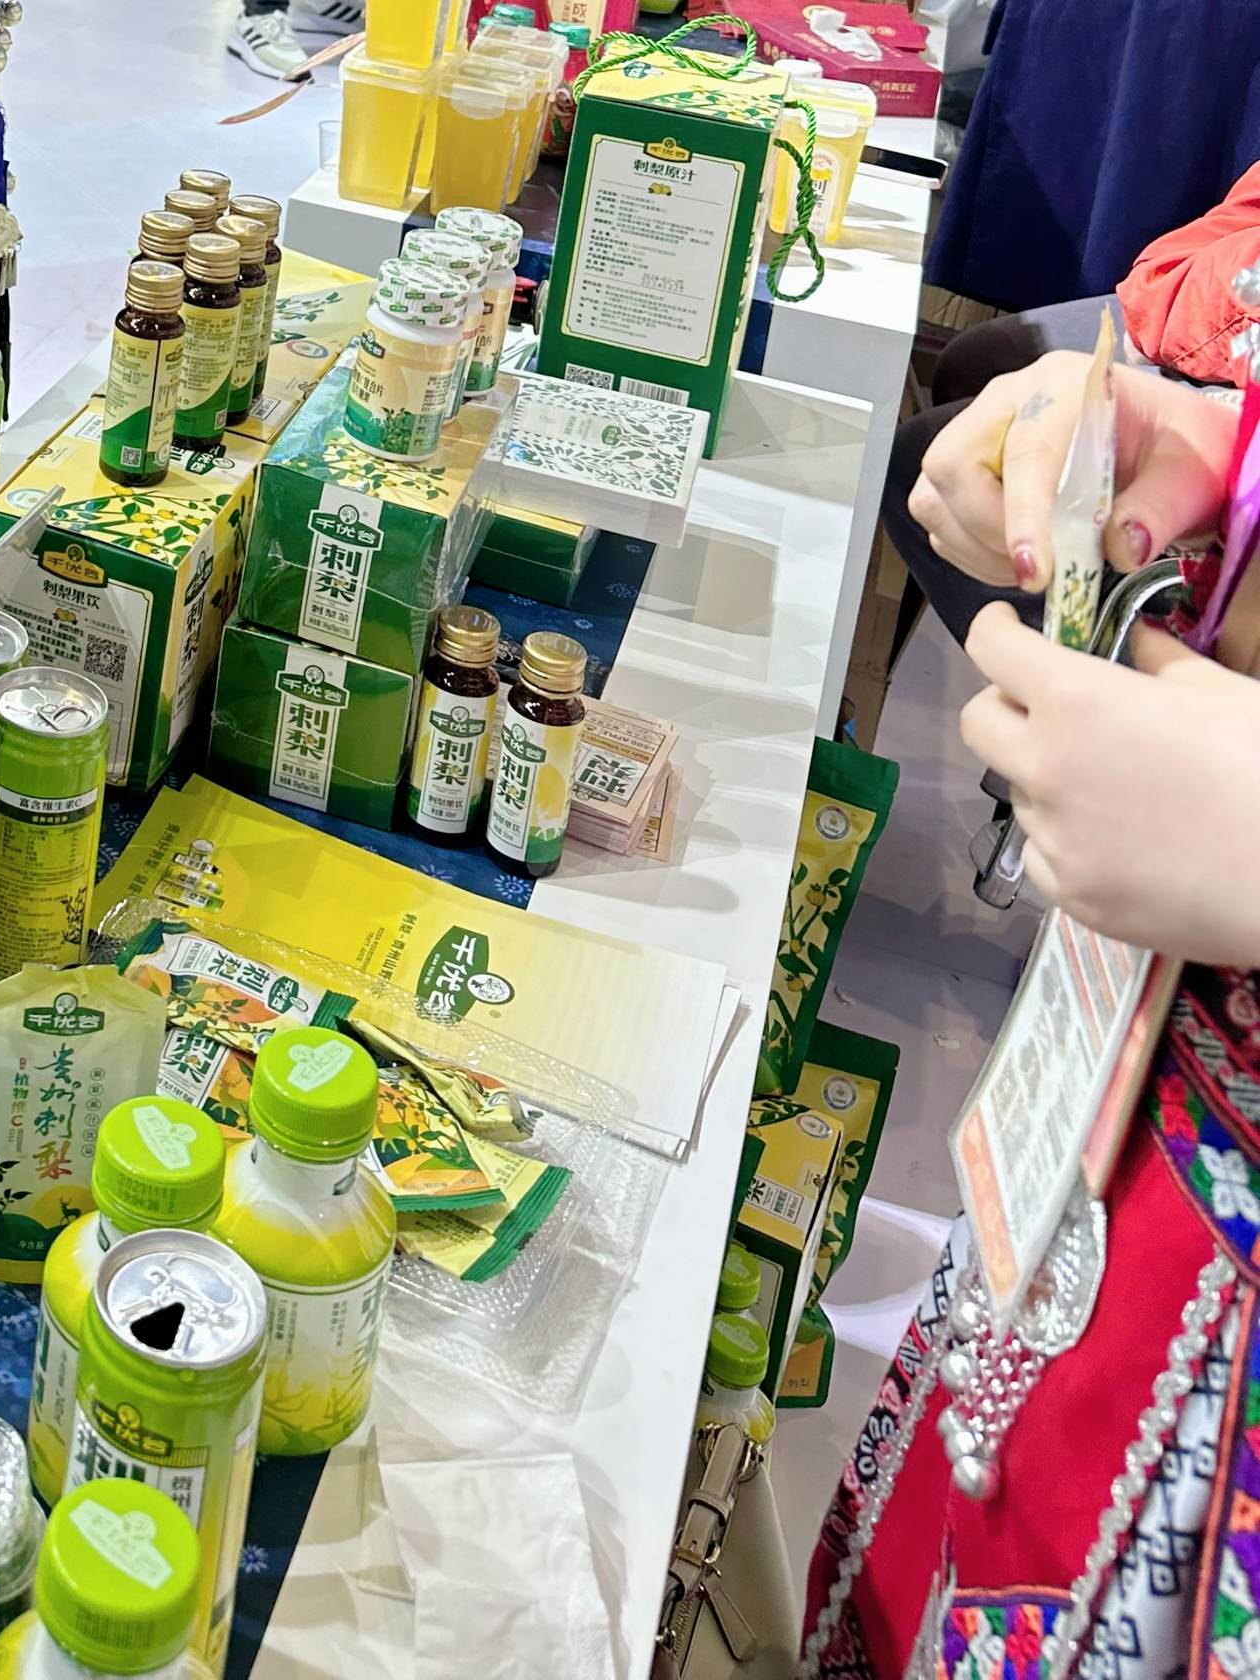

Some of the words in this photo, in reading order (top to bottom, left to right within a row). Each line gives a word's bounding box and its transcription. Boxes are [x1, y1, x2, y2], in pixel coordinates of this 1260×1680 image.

[633, 158, 697, 182] 刺梨原汁
[42, 579, 101, 610] 刺梨果饮
[314, 542, 362, 604] 刺梨
[283, 703, 330, 761] 刺梨
[434, 735, 474, 787] 刺梨
[498, 753, 529, 811] 刺梨
[208, 950, 271, 994] 刺梨
[28, 1013, 101, 1028] 千优谷
[34, 1041, 83, 1180] 贵州刺梨
[18, 1239, 45, 1251] 净含量
